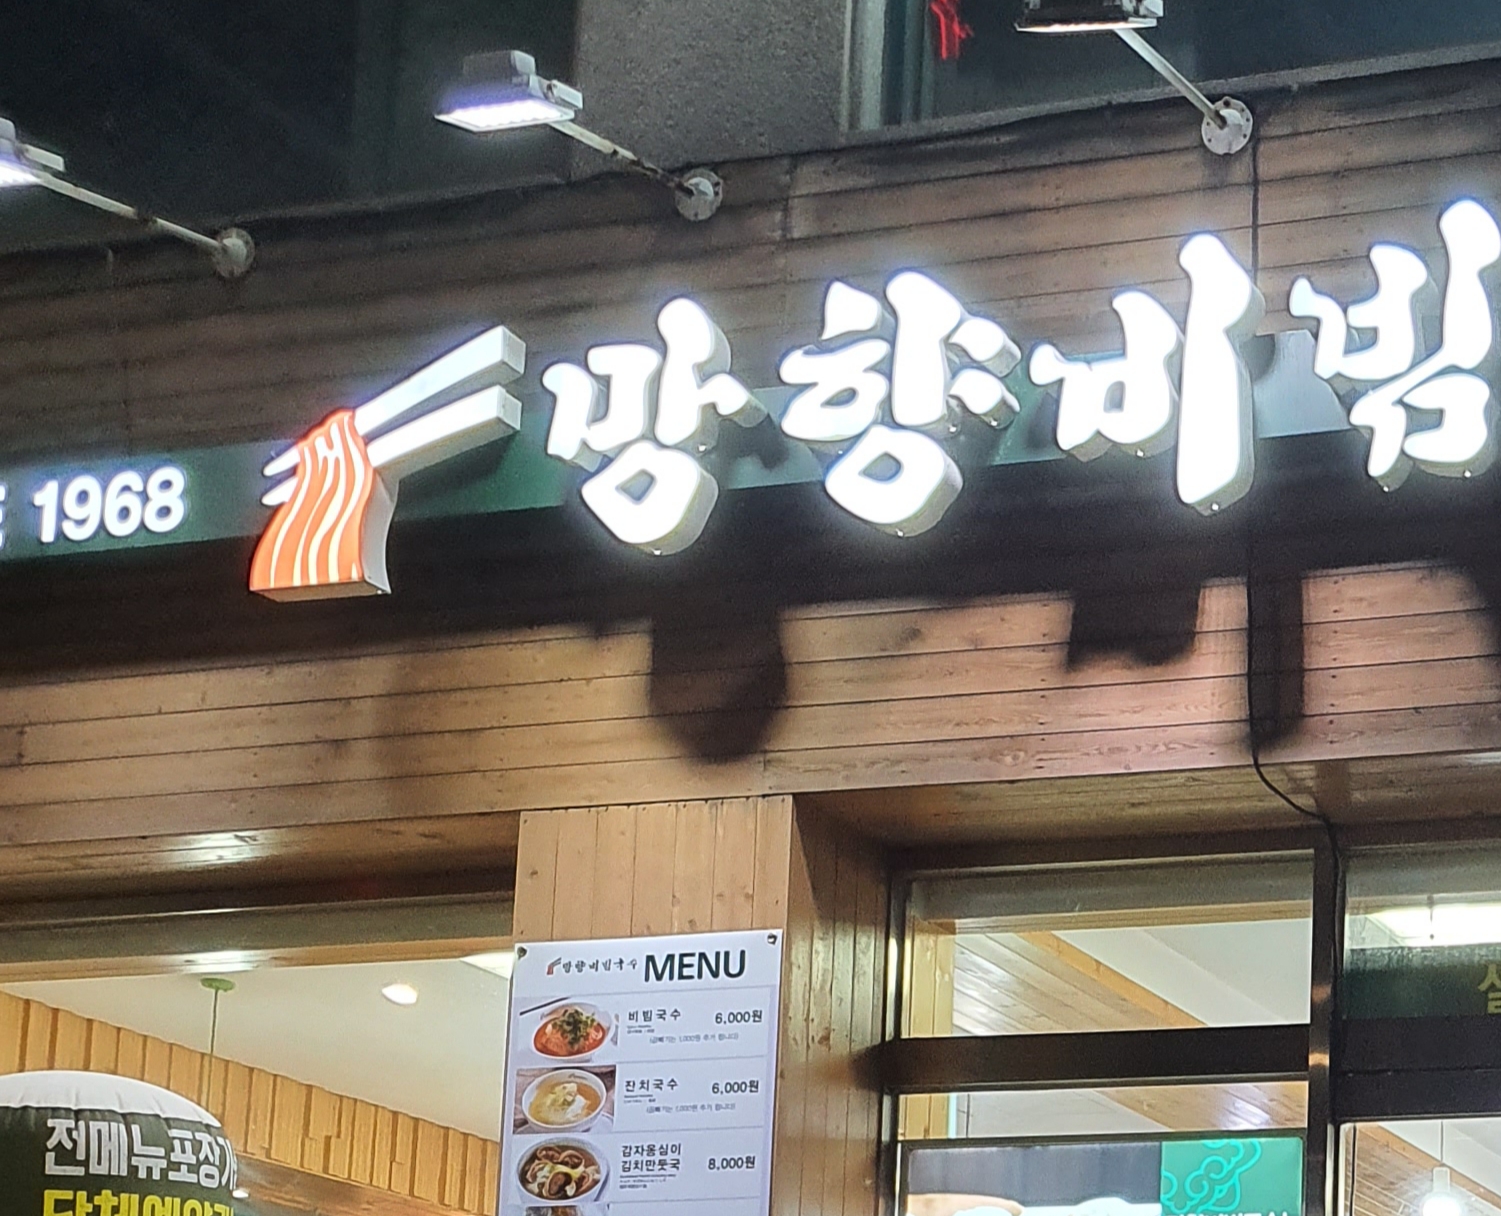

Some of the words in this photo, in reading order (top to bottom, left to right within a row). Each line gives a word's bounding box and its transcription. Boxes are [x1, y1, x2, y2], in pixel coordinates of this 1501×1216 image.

[33, 465, 187, 544] 1968
[562, 958, 638, 974] 망향비빔국수
[643, 950, 747, 983] MENU
[628, 1009, 682, 1023] 비빔국수
[715, 1009, 763, 1025] 6,000원
[625, 1078, 680, 1093] 잔치국수
[711, 1079, 760, 1096] 6,000원
[707, 1155, 756, 1171] 8,000원
